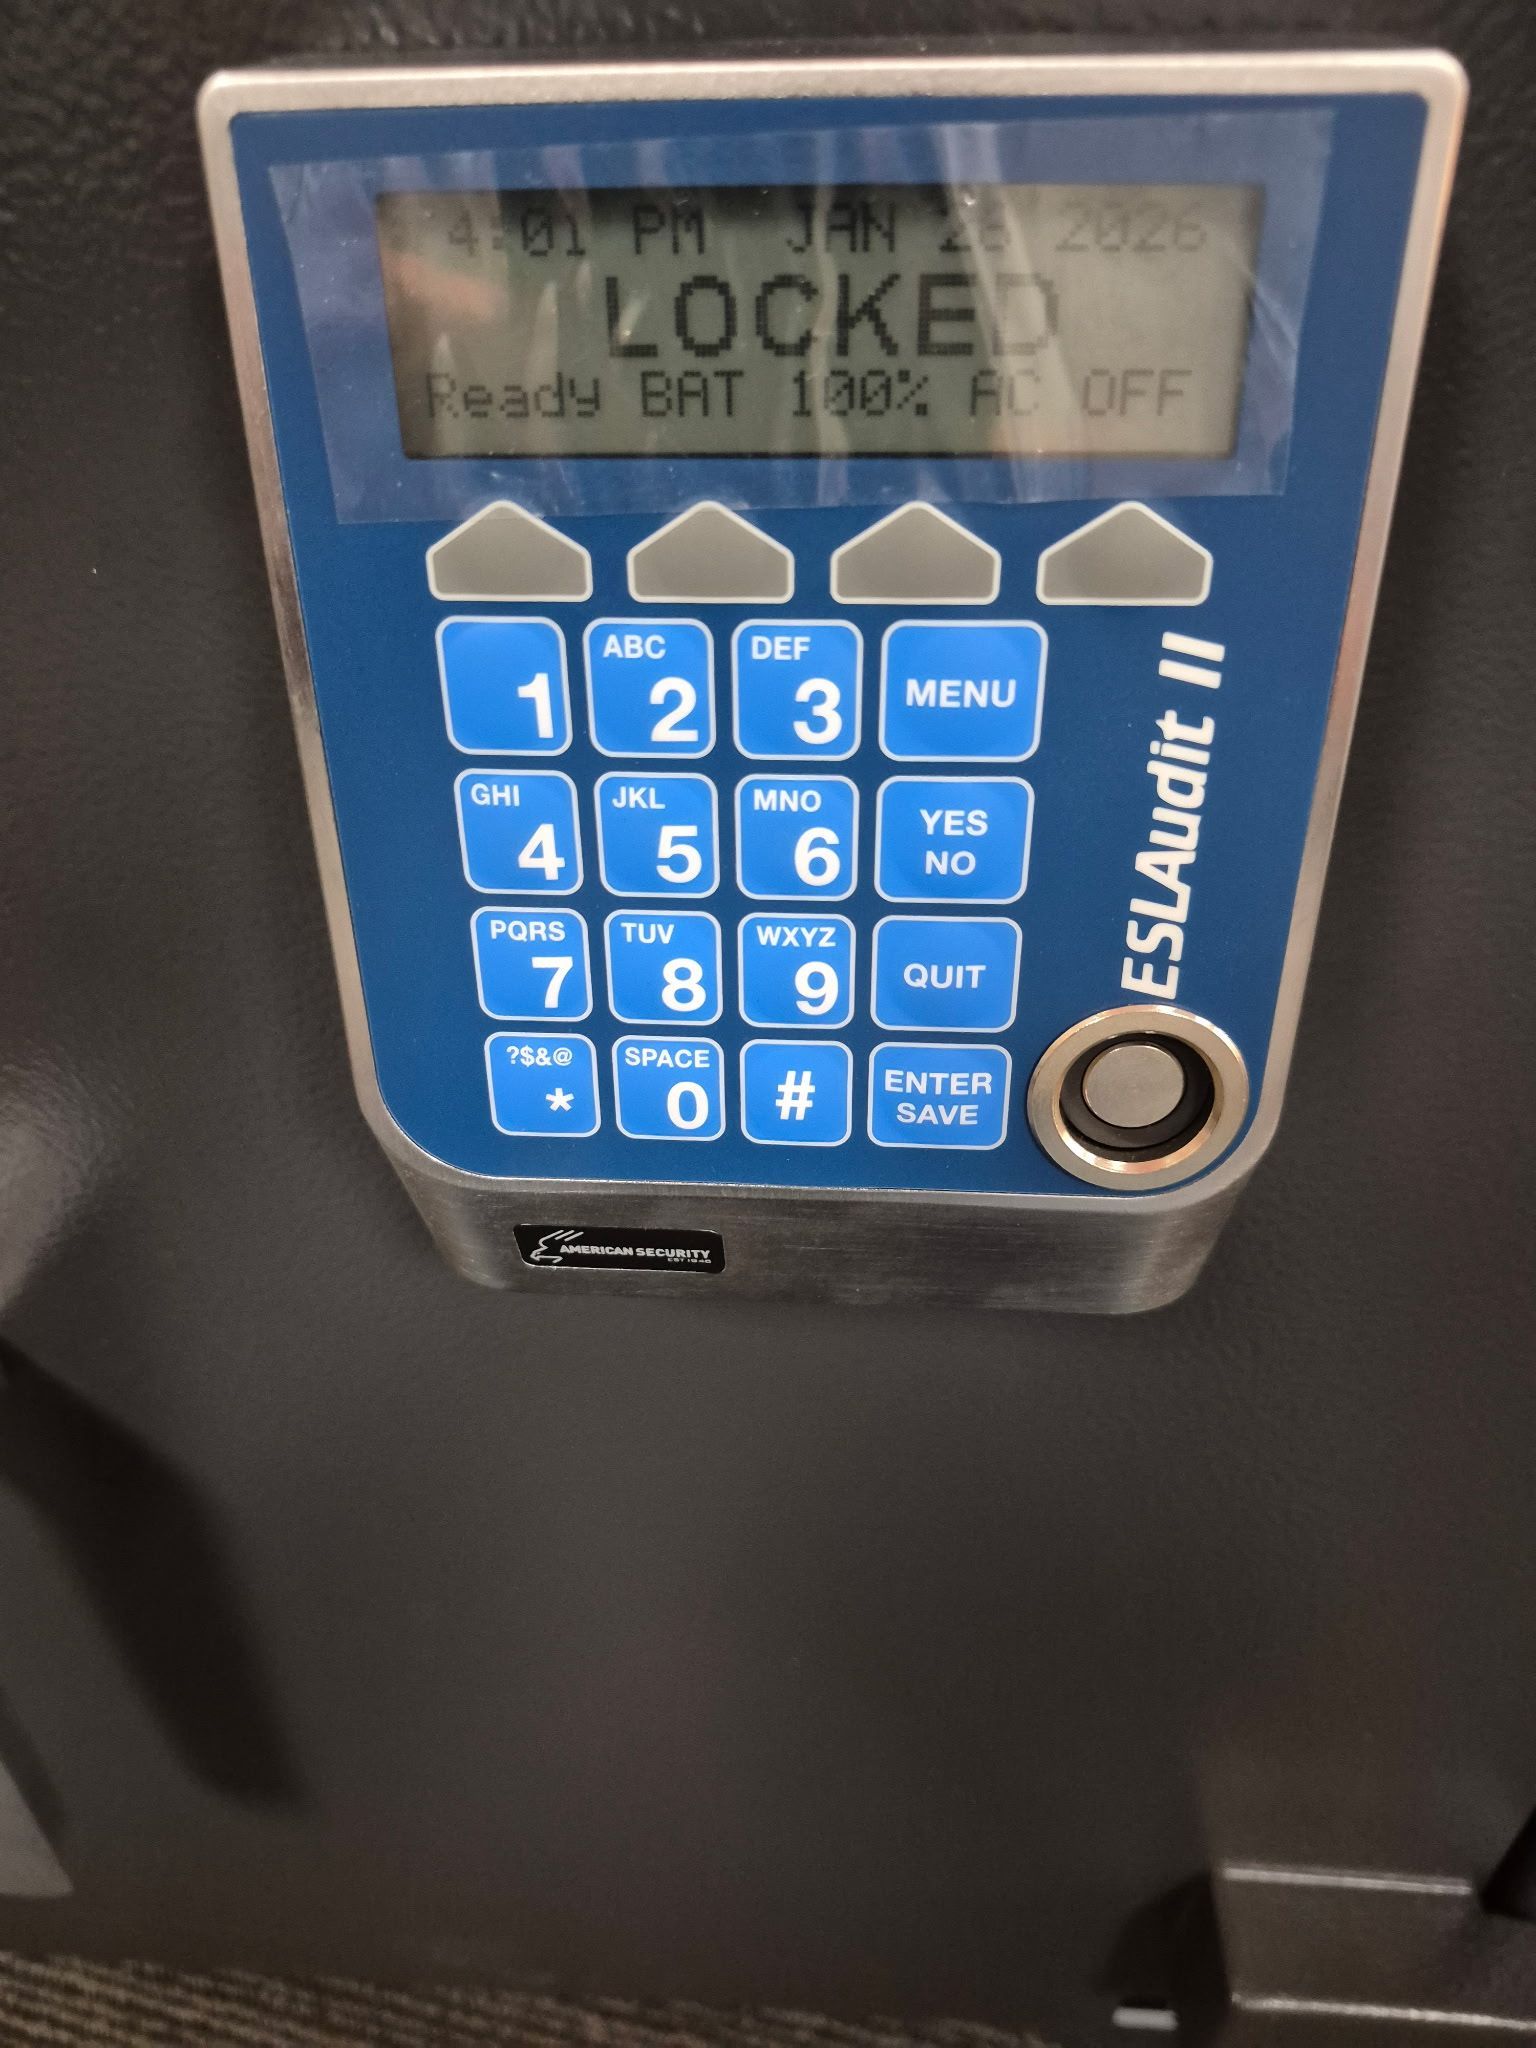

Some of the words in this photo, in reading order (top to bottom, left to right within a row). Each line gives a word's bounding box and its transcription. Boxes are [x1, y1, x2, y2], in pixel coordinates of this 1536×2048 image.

[633, 206, 704, 255] PM
[786, 204, 896, 254] JAN
[1055, 203, 1207, 254] 2026
[606, 273, 1058, 358] LOCKED
[426, 370, 600, 418] Ready
[641, 370, 744, 417] BAT
[793, 369, 928, 417] 100%
[971, 368, 1040, 417] AC
[1083, 368, 1193, 417] OFF
[603, 635, 667, 659] ABC
[751, 636, 811, 660] DEF
[517, 673, 554, 739] 1
[906, 679, 1016, 708] MENU
[649, 677, 699, 742] 2
[793, 678, 842, 744] 3
[470, 783, 520, 807] GHI
[612, 787, 666, 810] JKL
[753, 789, 822, 813] MNO
[920, 809, 988, 836] YES
[518, 824, 566, 881] 4
[656, 825, 702, 884] 5
[794, 827, 841, 886] 6
[925, 851, 976, 876] NO
[1120, 709, 1215, 1000] ESLAudit
[490, 919, 566, 942] PQRS
[620, 922, 675, 944] TUV
[756, 925, 836, 948] WXYZ
[531, 956, 573, 1009] 7
[661, 958, 706, 1012] 8
[794, 961, 839, 1016] 9
[903, 964, 986, 989] QUIT
[506, 1045, 573, 1067] ?$&@
[624, 1047, 710, 1069] SPACE
[775, 1070, 816, 1121] #
[884, 1070, 993, 1095] ENTER
[666, 1081, 709, 1130] 0
[896, 1103, 979, 1126] SAVE
[560, 1244, 634, 1257] AMERICAN
[636, 1247, 711, 1258] SECURITY
